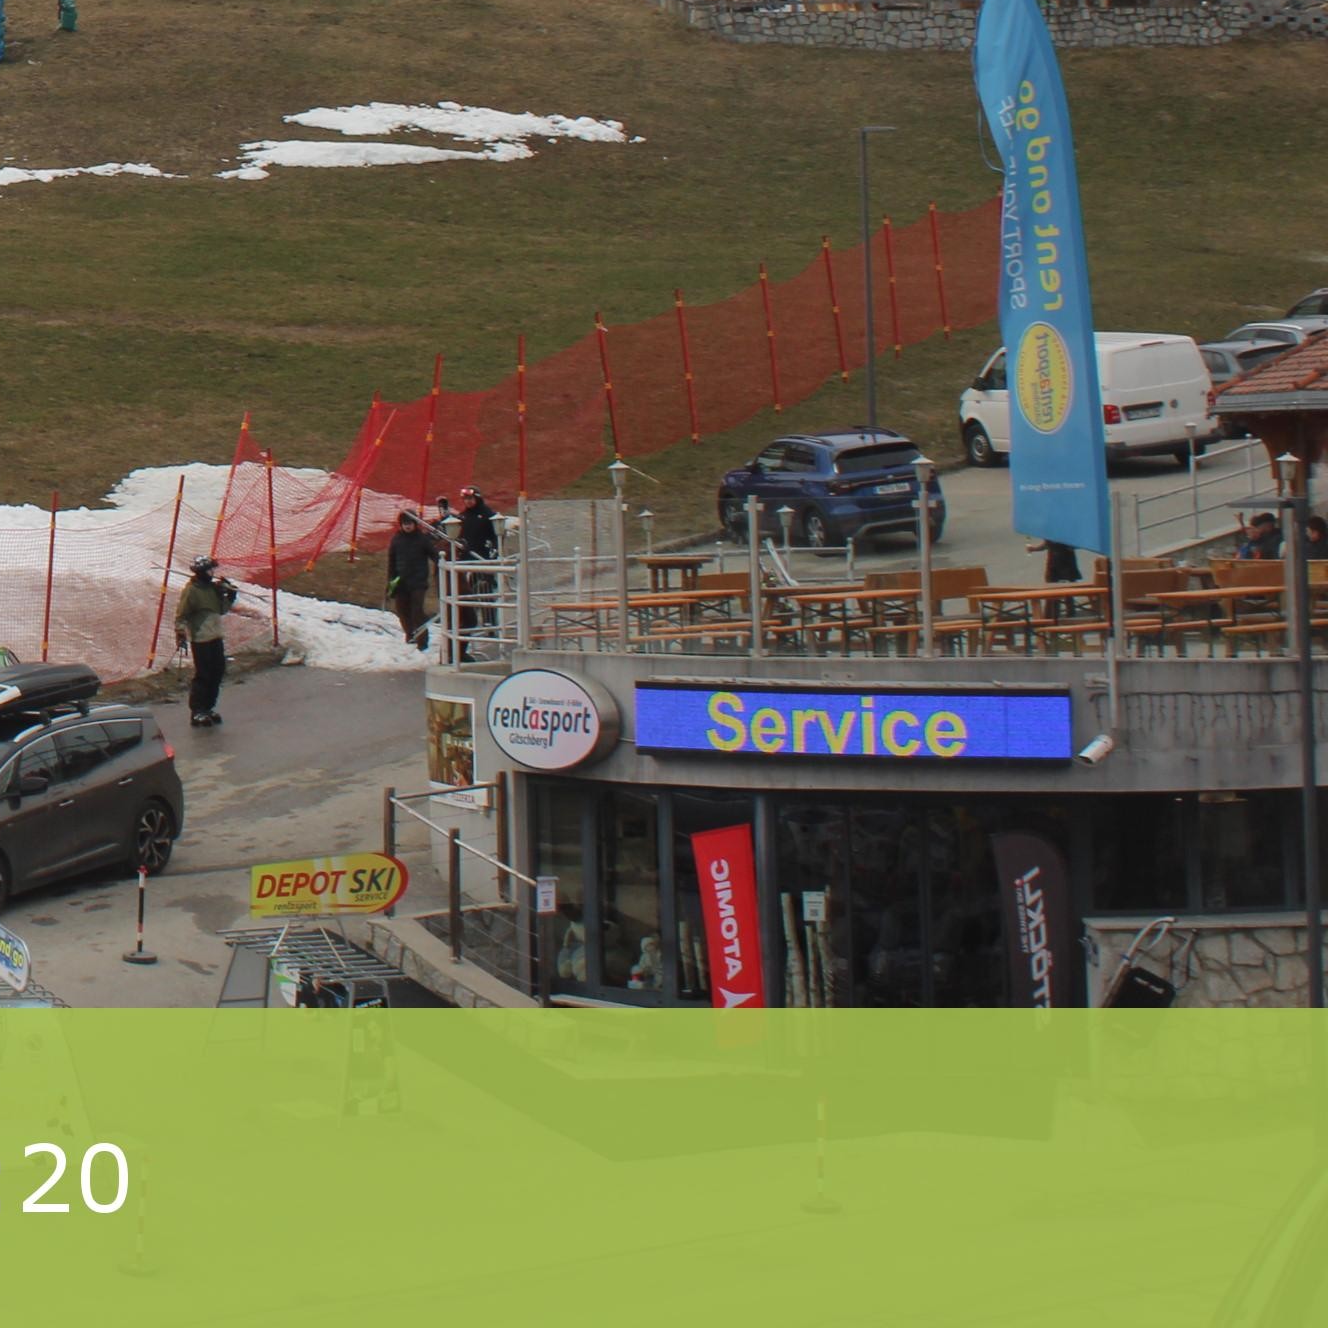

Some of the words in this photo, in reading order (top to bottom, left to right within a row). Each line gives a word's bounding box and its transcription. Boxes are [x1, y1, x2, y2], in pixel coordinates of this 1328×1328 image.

[493, 696, 592, 747] rentasport
[706, 692, 969, 757] Service
[256, 870, 347, 899] DEPOT
[349, 867, 396, 894] SKI
[11, 949, 25, 967] go
